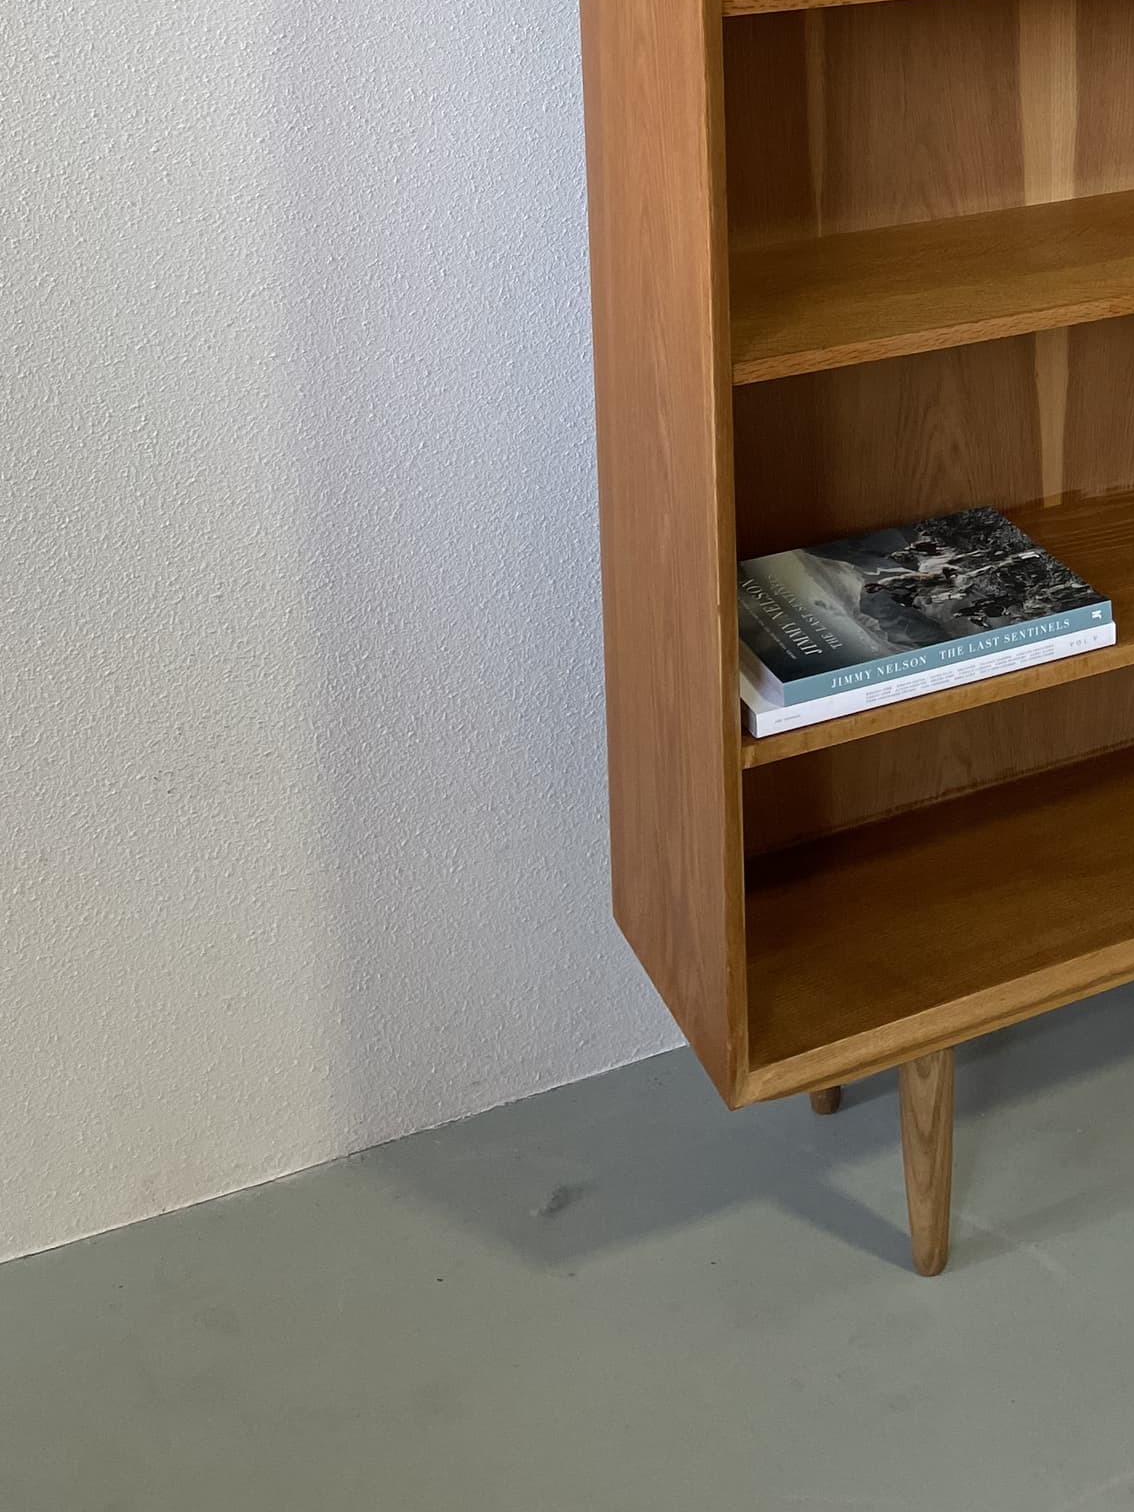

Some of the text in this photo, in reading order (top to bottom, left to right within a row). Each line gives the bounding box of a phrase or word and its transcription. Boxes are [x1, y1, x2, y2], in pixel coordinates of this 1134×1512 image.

[741, 578, 784, 620] NELSON
[781, 622, 823, 655] JIMMY
[820, 634, 843, 649] THE
[831, 618, 1071, 689] JIMMY NELSON THE LAST SENTINELS
